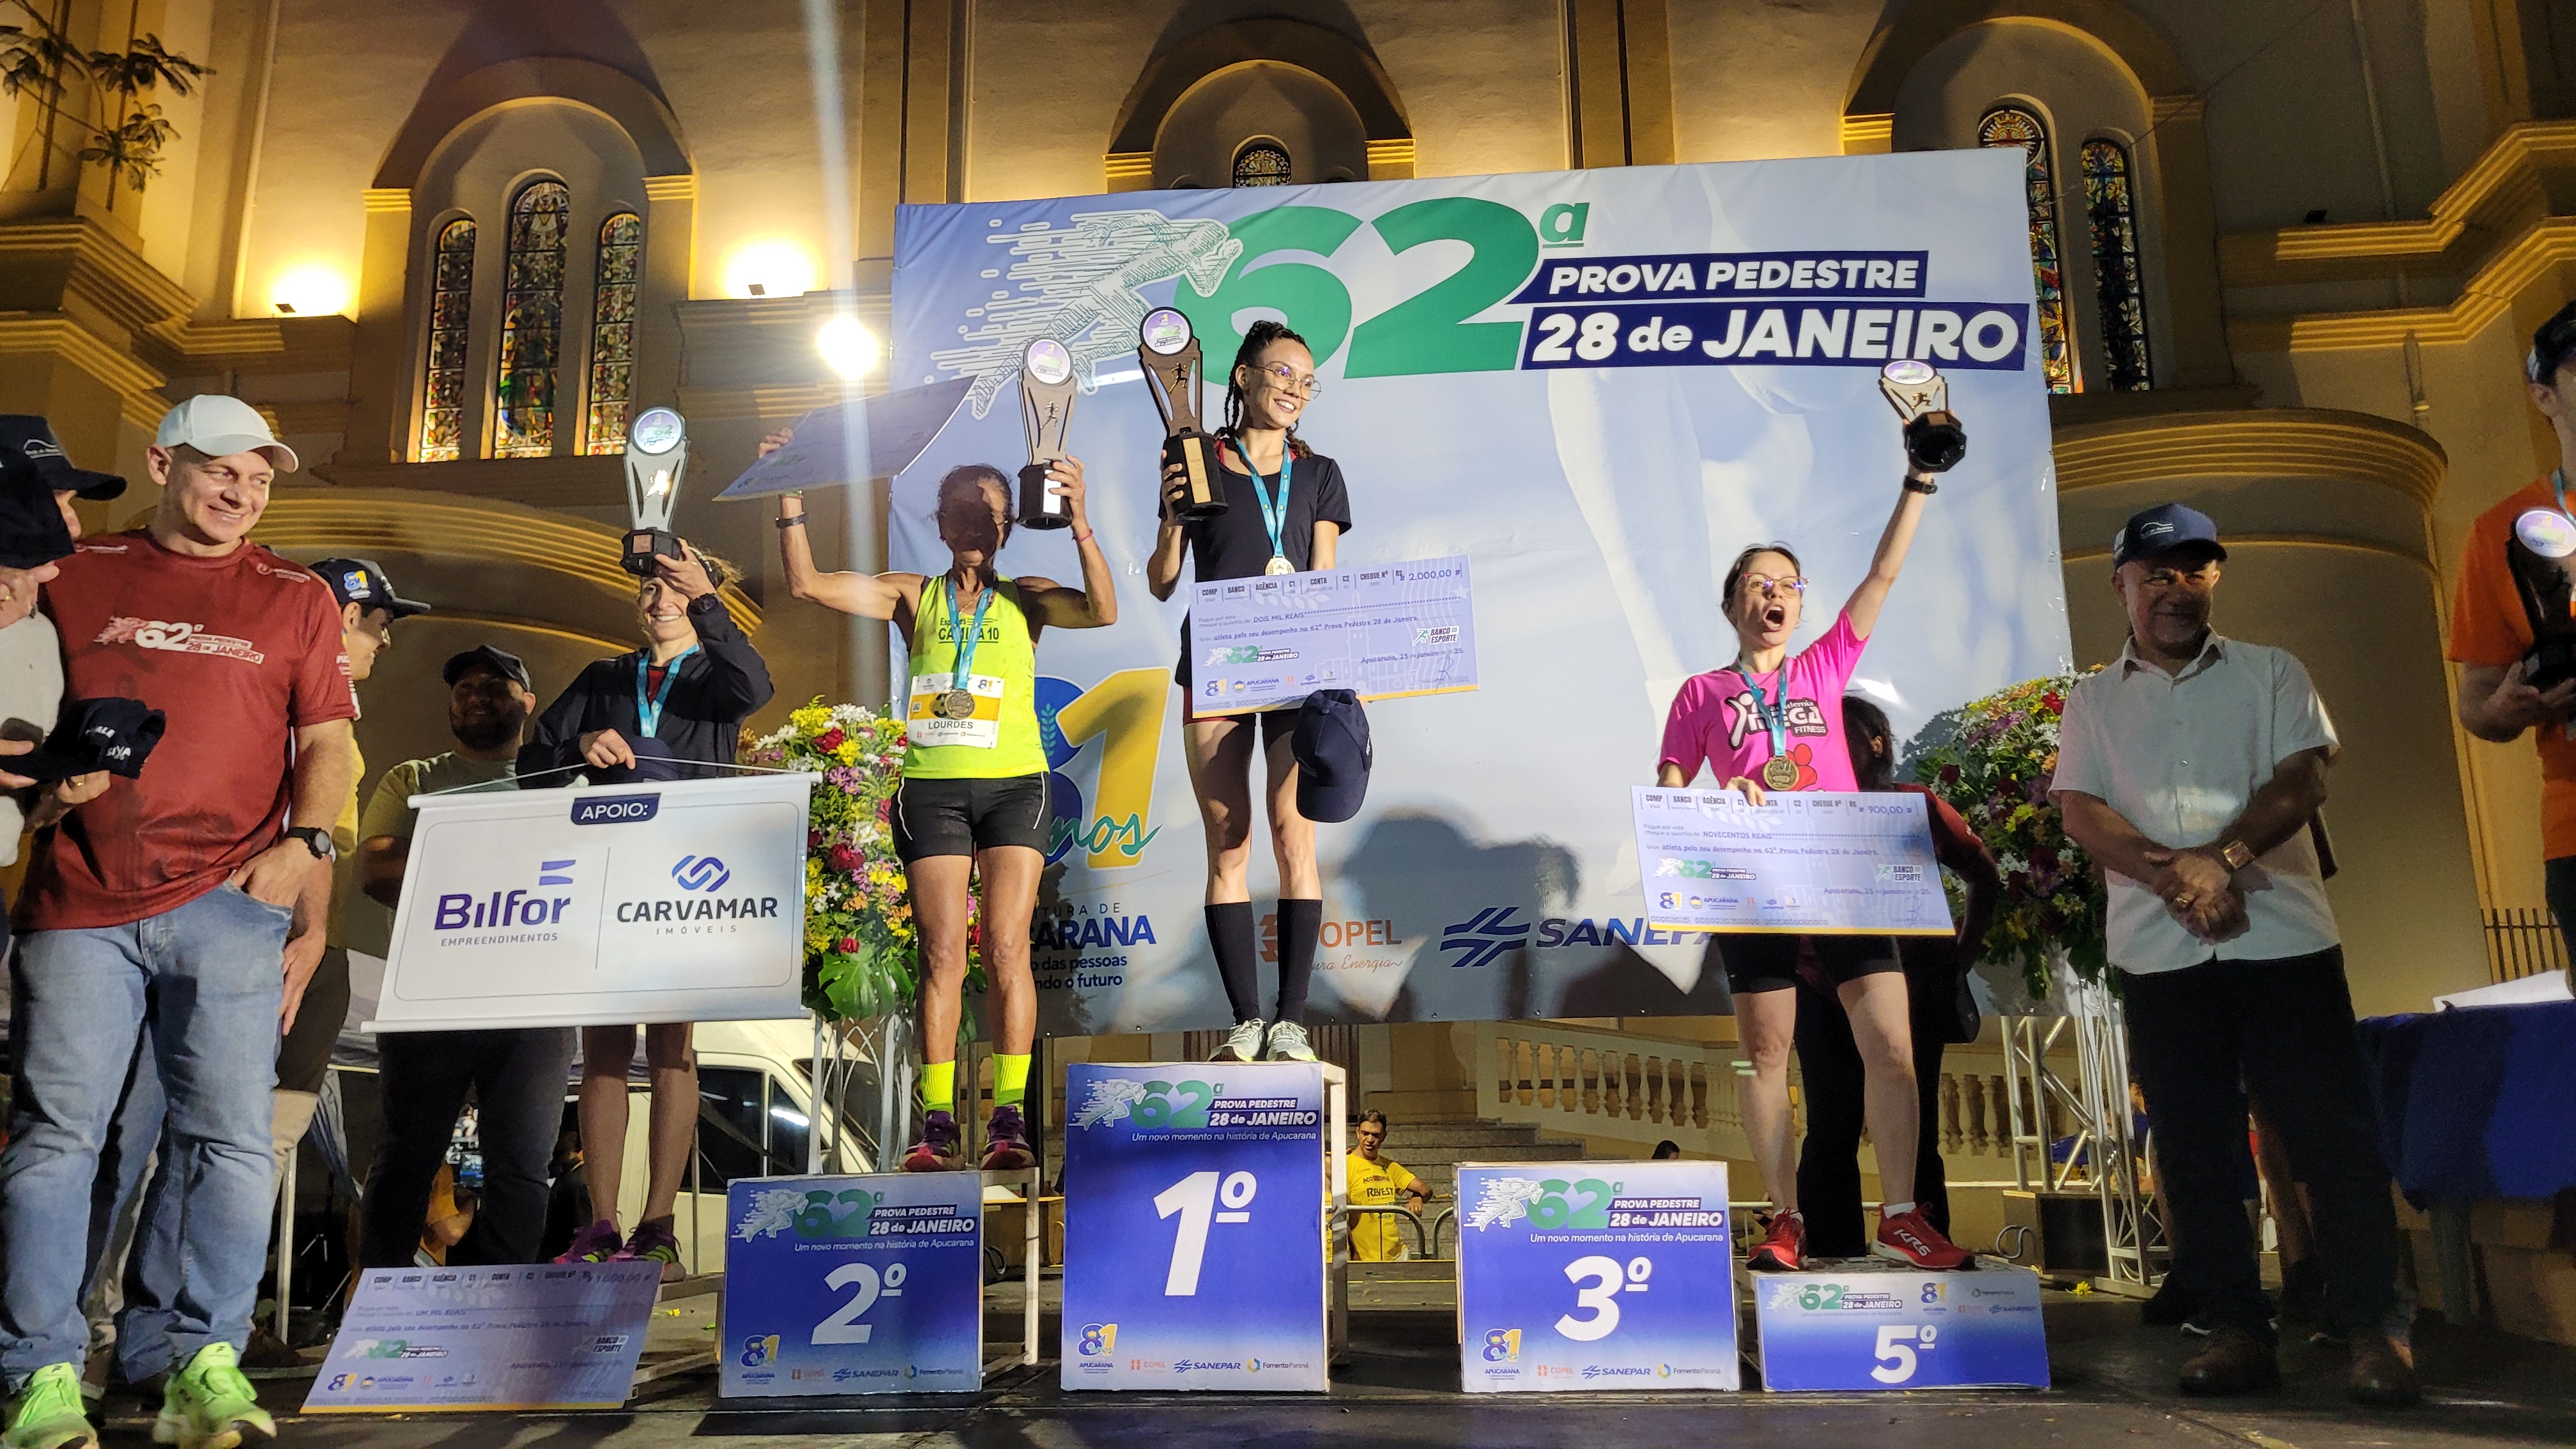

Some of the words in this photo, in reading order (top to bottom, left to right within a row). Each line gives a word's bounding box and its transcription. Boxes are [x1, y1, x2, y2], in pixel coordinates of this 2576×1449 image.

[1549, 263, 1695, 295] PROVA
[1705, 259, 1920, 290] PEDESTRE
[1532, 311, 1620, 362] 28
[1627, 316, 1694, 352] de
[1702, 309, 2020, 363] JANEIRO
[1227, 585, 1245, 594] BANCO
[1255, 582, 1278, 591] AGÊNCIA
[1310, 577, 1328, 585] CONTA
[1360, 572, 1381, 580] CHEQUE
[1408, 569, 1452, 581] 2.000,00
[987, 627, 999, 640] 10
[1214, 632, 1232, 641] atleta
[1261, 627, 1298, 636] desempenho
[1344, 620, 1371, 628] Pedestre
[1430, 627, 1451, 636] BANCO
[1430, 634, 1457, 644] ESPORTE
[211, 645, 261, 663] JANEIRO
[1271, 652, 1298, 661] JANEIRO
[1416, 651, 1439, 659] janeiro
[1205, 678, 1227, 697] 81
[928, 721, 974, 730] LOURDES
[1794, 726, 1827, 734] FITNESS
[579, 802, 648, 821] APOIO:
[1703, 795, 1726, 805] AGÊNCIA
[1867, 806, 1903, 815] 900,00
[1713, 845, 1751, 854] desempenho
[434, 889, 571, 930] Bilfor
[617, 896, 778, 923] CARVAMAR
[1099, 902, 1121, 914] DE
[1659, 892, 1682, 910] 81
[656, 924, 737, 936] IMÓVEIS
[1030, 914, 1157, 953] ARANA
[1319, 919, 1402, 948] OPEL
[440, 932, 558, 947] EMPREENDIMENTOS
[1041, 956, 1067, 972] das
[1070, 955, 1128, 973] pessoas
[1310, 960, 1336, 972] ura
[1341, 954, 1403, 974] Energia
[1065, 978, 1075, 988] o
[1077, 973, 1123, 988] futuro
[1131, 1080, 1224, 1128] 62ª
[1213, 1100, 1246, 1109] PROVA
[1248, 1100, 1296, 1108] PEDESTRE
[1209, 1113, 1231, 1126] 28
[1230, 1114, 1246, 1124] de
[1246, 1112, 1317, 1126] JANEIRO
[1131, 1133, 1147, 1141] Um
[1171, 1133, 1213, 1141] momento
[1225, 1131, 1257, 1141] história
[1259, 1131, 1270, 1140] de
[1271, 1131, 1316, 1142] Apucarana
[1366, 1187, 1393, 1198] REVEST
[874, 1209, 907, 1218] PROVA
[908, 1206, 955, 1216] PEDESTRE
[1528, 1178, 1624, 1230] 62ª
[1614, 1200, 1648, 1209] PROVA
[1650, 1199, 1700, 1209] PEDESTRE
[793, 1188, 885, 1239] 62ª
[1610, 1213, 1631, 1227] 28
[1632, 1215, 1648, 1225] de
[1648, 1213, 1723, 1227] JANEIRO
[870, 1221, 890, 1235] 28
[907, 1218, 975, 1234] JANEIRO
[1153, 1170, 1257, 1296] 1º
[794, 1243, 809, 1252] Um
[832, 1242, 873, 1251] momento
[885, 1239, 917, 1249] história
[930, 1238, 975, 1250] Apucarana
[1530, 1233, 1546, 1243] Um
[1571, 1233, 1614, 1242] momento
[1627, 1232, 1660, 1241] história
[1662, 1232, 1674, 1241] de
[1675, 1232, 1724, 1243] Apucarana
[1554, 1255, 1652, 1342] 3º
[1798, 1283, 1850, 1310] 62ª
[1920, 1282, 1947, 1304] 81
[810, 1262, 907, 1346] 2º
[1843, 1301, 1854, 1309] 28
[1862, 1301, 1902, 1309] JANEIRO
[593, 1344, 622, 1353] ESPORTE
[595, 1336, 619, 1344] BANCO
[1077, 1322, 1118, 1357] 81
[1481, 1328, 1522, 1363] 81
[741, 1334, 781, 1367] 81
[1869, 1324, 1938, 1385] 5º
[851, 1369, 899, 1378] SANEPAR
